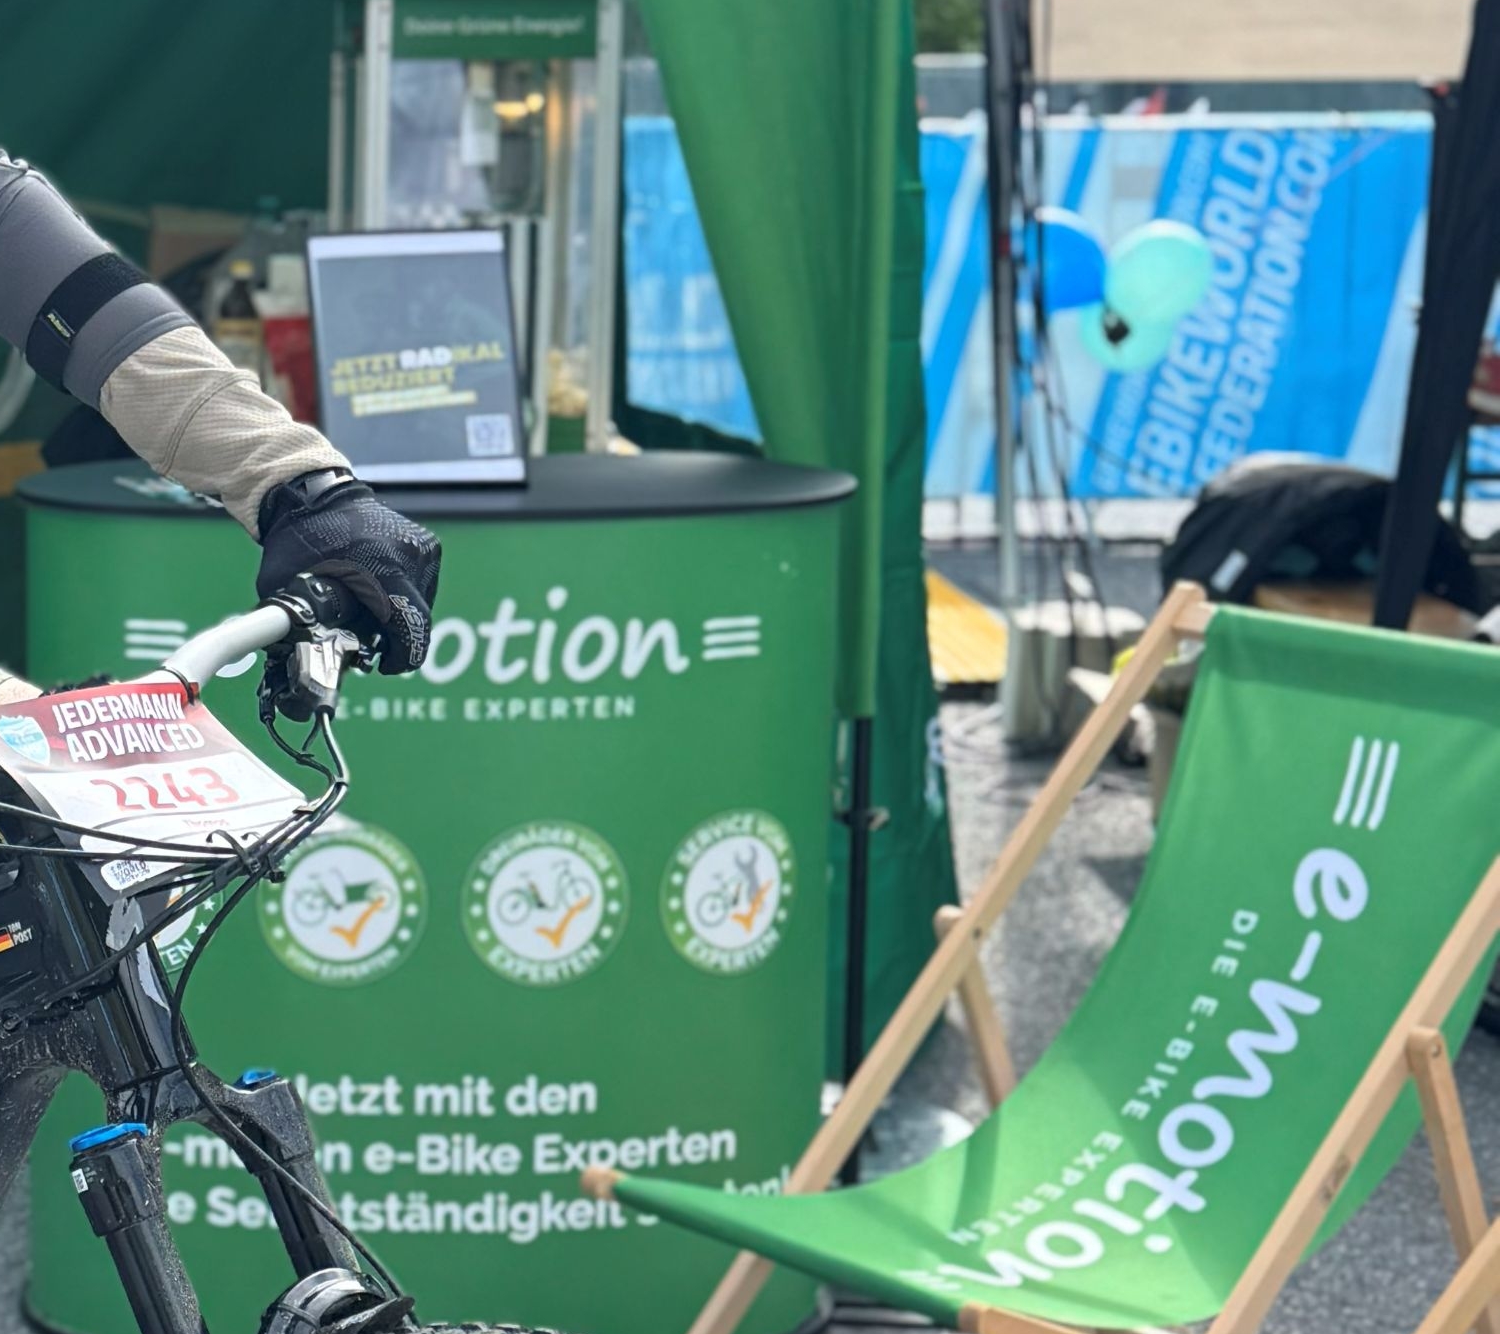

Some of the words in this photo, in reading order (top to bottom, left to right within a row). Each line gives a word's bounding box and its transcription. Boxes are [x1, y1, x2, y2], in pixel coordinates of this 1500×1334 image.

[51, 692, 186, 734] JEDERMANN
[334, 696, 448, 722] E-BIKE
[464, 695, 637, 721] EXPERTEN
[64, 721, 206, 765] ADVANCED
[89, 767, 241, 812] 2243
[676, 813, 753, 865] SERVICE
[12, 927, 32, 946] POST
[1209, 908, 1260, 979] DIE
[483, 945, 602, 982] EXPERTEN
[937, 847, 1370, 1291] e-motion
[1119, 993, 1219, 1121] E-BIKE
[414, 1075, 495, 1118] mit
[505, 1077, 599, 1117] den
[363, 1133, 521, 1176] e-Bike
[532, 1127, 739, 1177] Experten
[949, 1128, 1125, 1247] EXPERTEN
